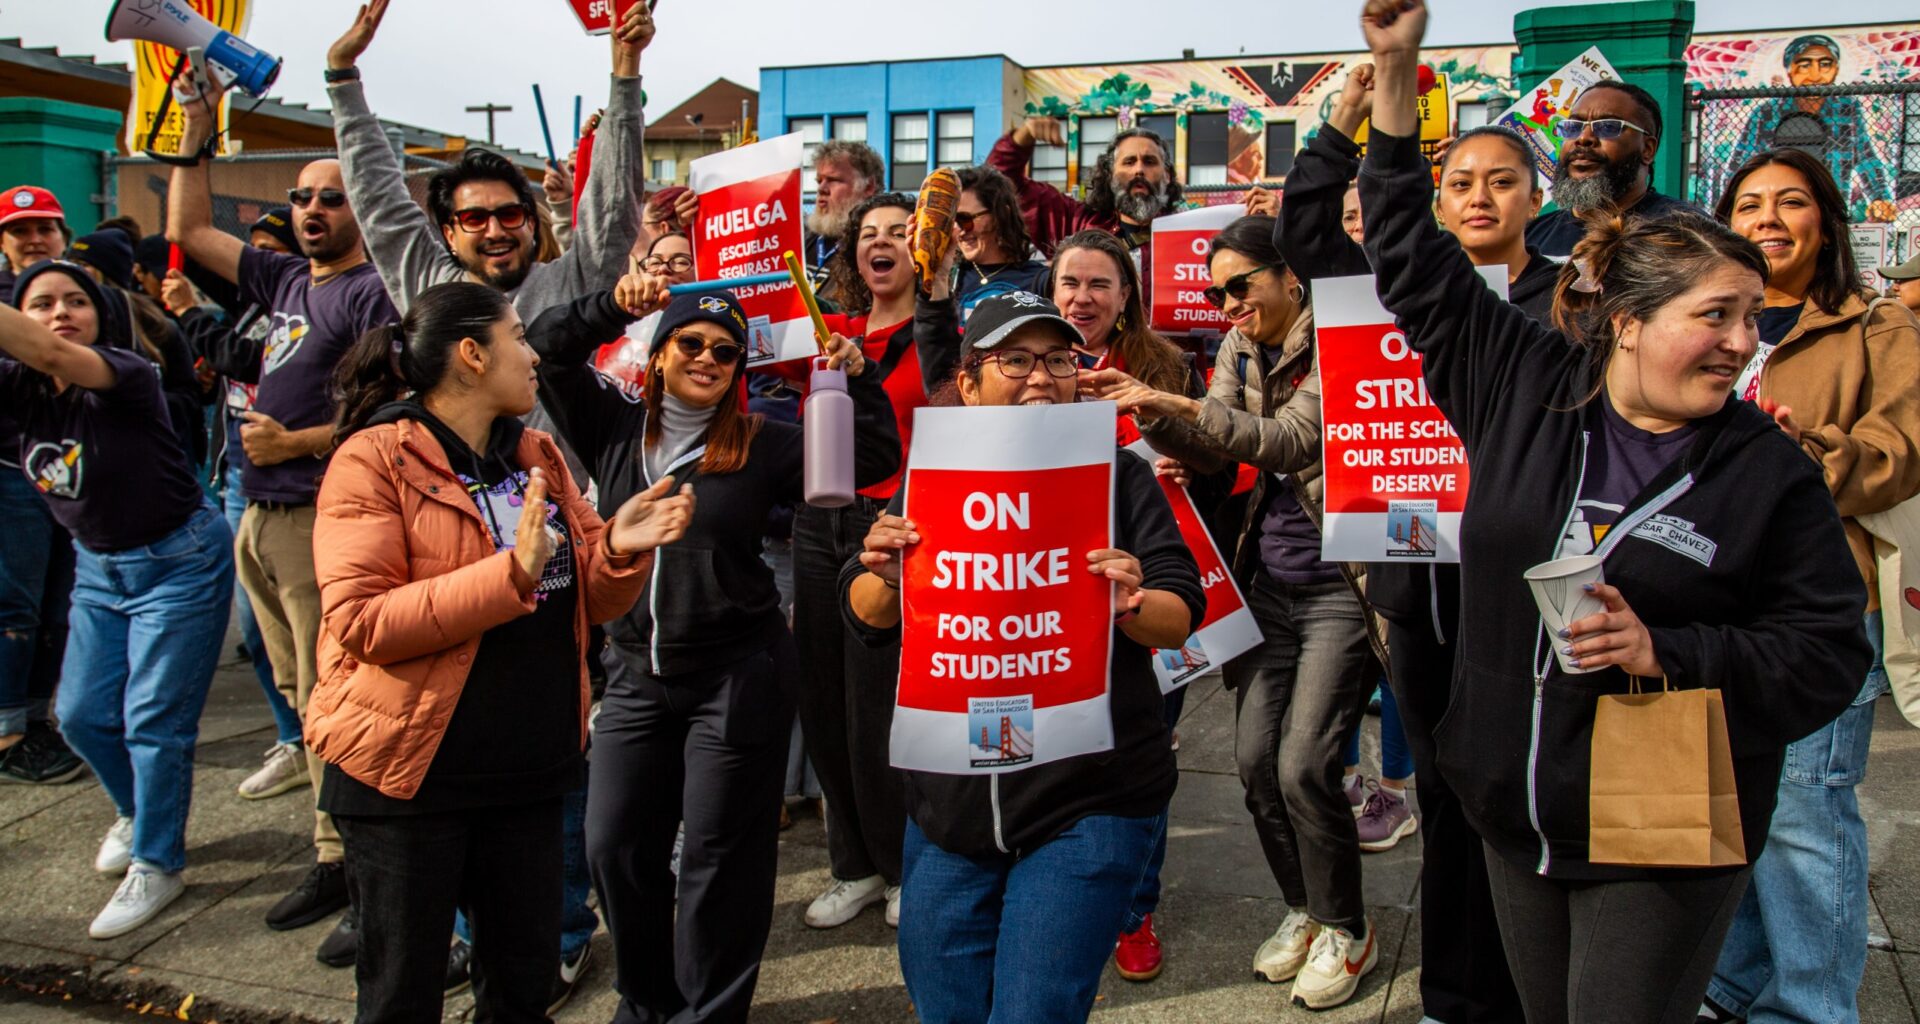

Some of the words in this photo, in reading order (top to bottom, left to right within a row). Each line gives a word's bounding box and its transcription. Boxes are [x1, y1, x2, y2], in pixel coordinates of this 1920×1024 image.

[164, 2, 190, 24] PYLE
[1581, 55, 1600, 73] WE
[705, 199, 788, 241] HUELGA
[718, 234, 779, 266] ¡ESCUELAS
[1191, 237, 1212, 256] O
[718, 260, 771, 280] SEGURAS
[771, 255, 781, 270] Y
[1177, 290, 1206, 304] FOR
[1173, 308, 1230, 323] STUDEN
[1355, 377, 1436, 410] STRI
[1326, 422, 1366, 442] FOR
[1368, 421, 1404, 440] THE
[1343, 448, 1386, 467] OUR
[1389, 447, 1469, 466] STUDEN
[1372, 473, 1456, 494] DESERVE
[962, 491, 1030, 531] ON
[1668, 529, 1709, 554] CHÁVEZ
[931, 547, 1070, 592] STRIKE
[937, 612, 993, 642] FOR
[999, 610, 1064, 641] OUR
[929, 647, 1072, 680] STUDENTS
[972, 700, 995, 708] UNITED
